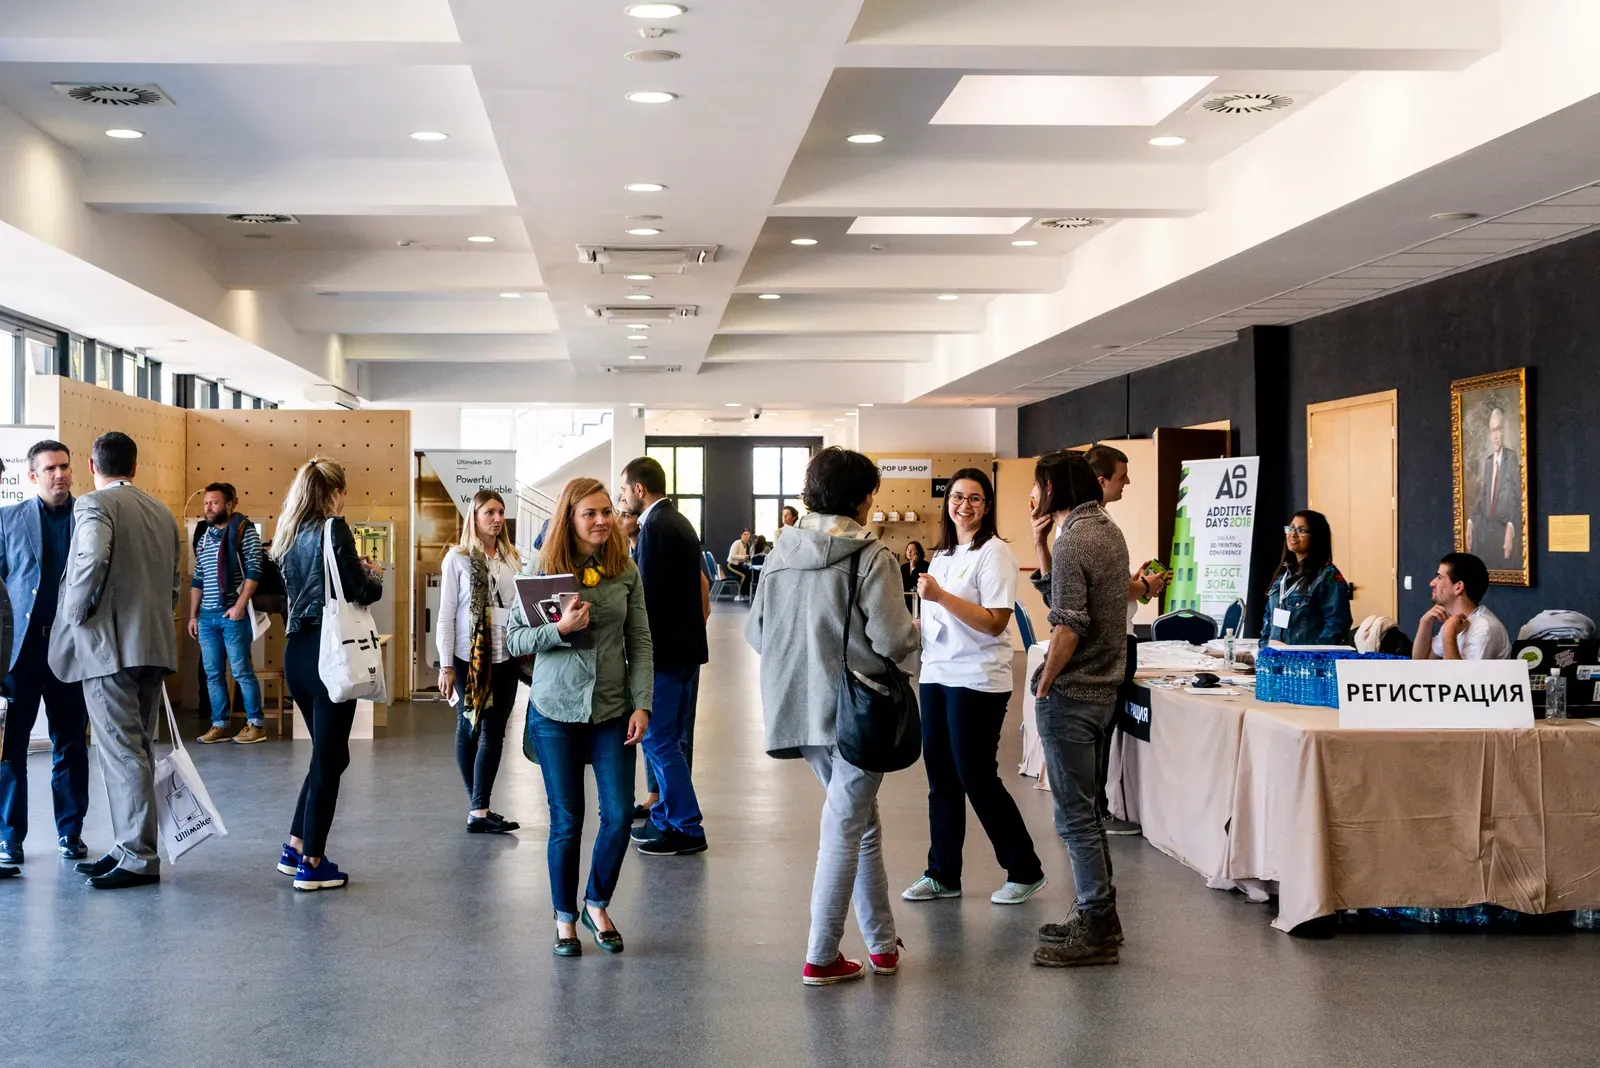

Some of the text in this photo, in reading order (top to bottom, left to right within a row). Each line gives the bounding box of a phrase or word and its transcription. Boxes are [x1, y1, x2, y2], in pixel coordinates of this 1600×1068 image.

[456, 475, 492, 484] Powerful
[1, 489, 24, 502] ting
[1206, 505, 1252, 517] ADDITIVE
[1205, 517, 1252, 528] DAYS 2018
[1207, 580, 1236, 589] SOFIA
[1346, 683, 1524, 708] РЕГИСТРАЦИЯ
